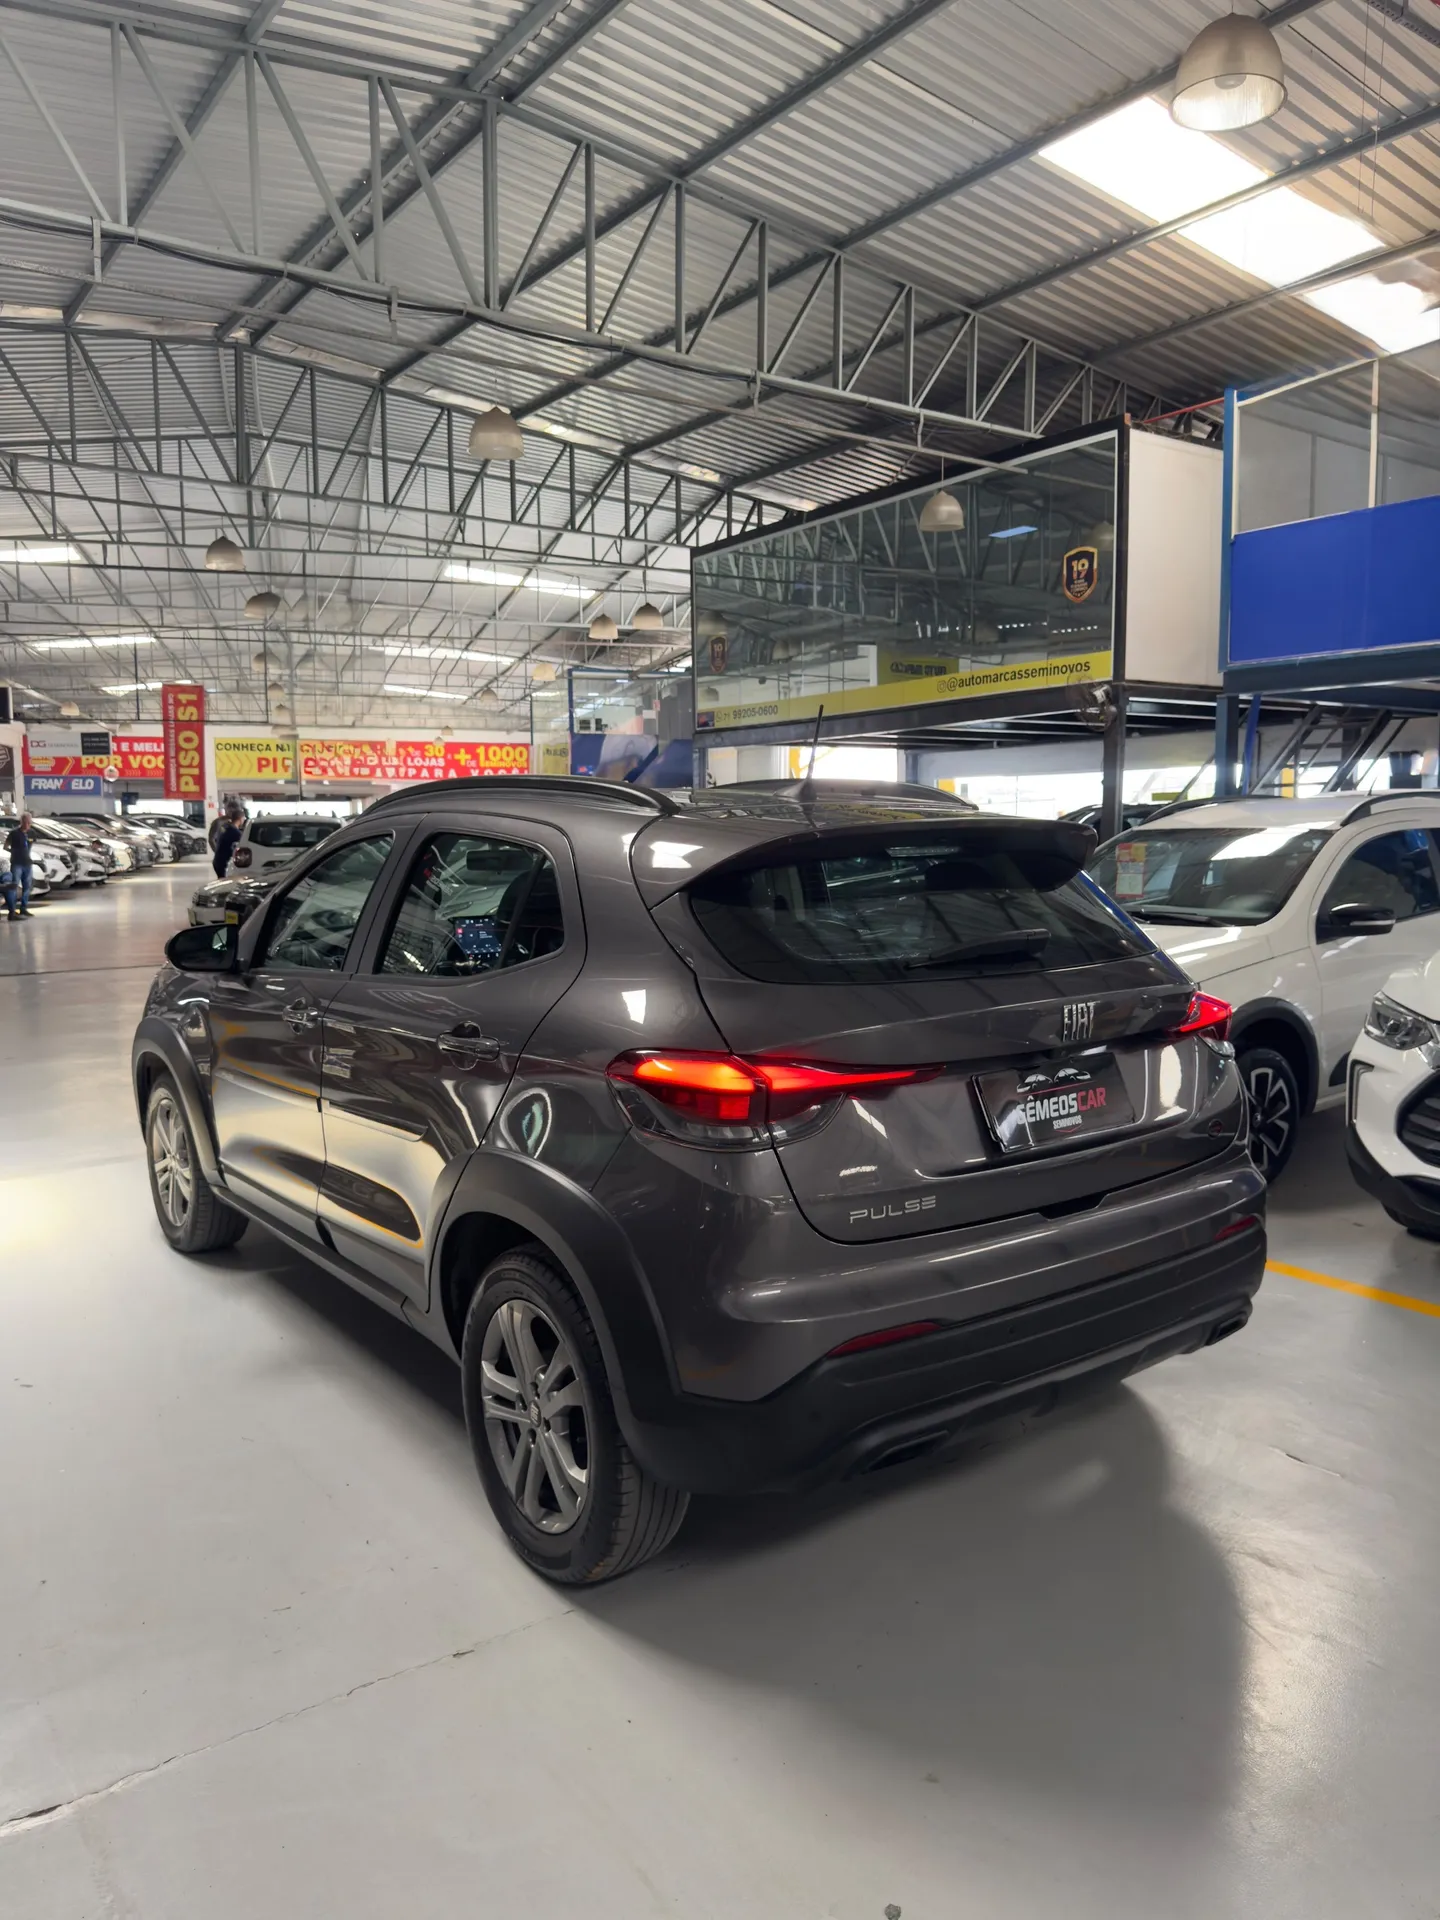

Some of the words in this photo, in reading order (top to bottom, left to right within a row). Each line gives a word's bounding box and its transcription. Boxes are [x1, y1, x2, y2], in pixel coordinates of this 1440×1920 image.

[946, 661, 1091, 692] @automarcasseminovos
[177, 693, 199, 721] S1
[732, 704, 779, 720] 99205-0600
[30, 740, 47, 748] DG
[216, 742, 272, 753] CONHEÇA
[424, 744, 446, 758] 30
[81, 755, 122, 768] POR
[178, 730, 200, 793] PISO
[407, 757, 446, 767] LOJAS
[476, 744, 529, 767] 1000
[407, 767, 458, 778] PARA
[1063, 1001, 1101, 1042] FIAT
[1053, 1115, 1083, 1130] SEMINOVOS
[849, 1195, 937, 1224] PULSE
